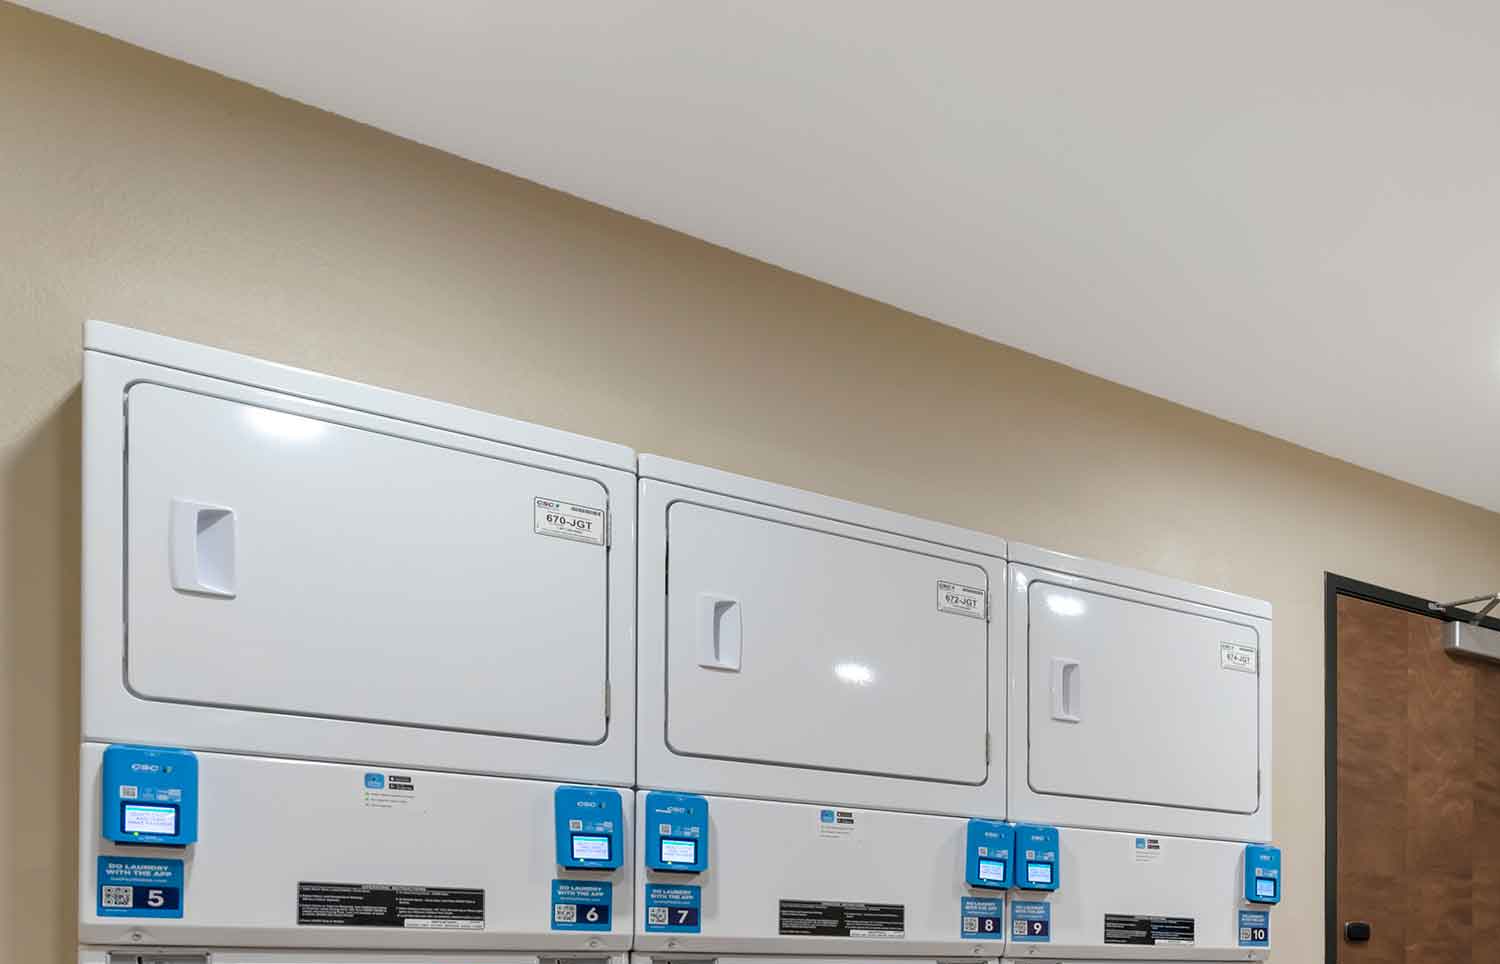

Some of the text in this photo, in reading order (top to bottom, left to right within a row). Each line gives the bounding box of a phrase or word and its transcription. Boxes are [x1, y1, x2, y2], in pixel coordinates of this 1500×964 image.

[546, 513, 592, 529] 670-JGT
[147, 889, 164, 907] 5
[586, 907, 599, 922] 6
[678, 910, 689, 924] 7
[985, 919, 994, 932] 8
[1033, 922, 1042, 935] 9
[1252, 929, 1265, 940] 10
